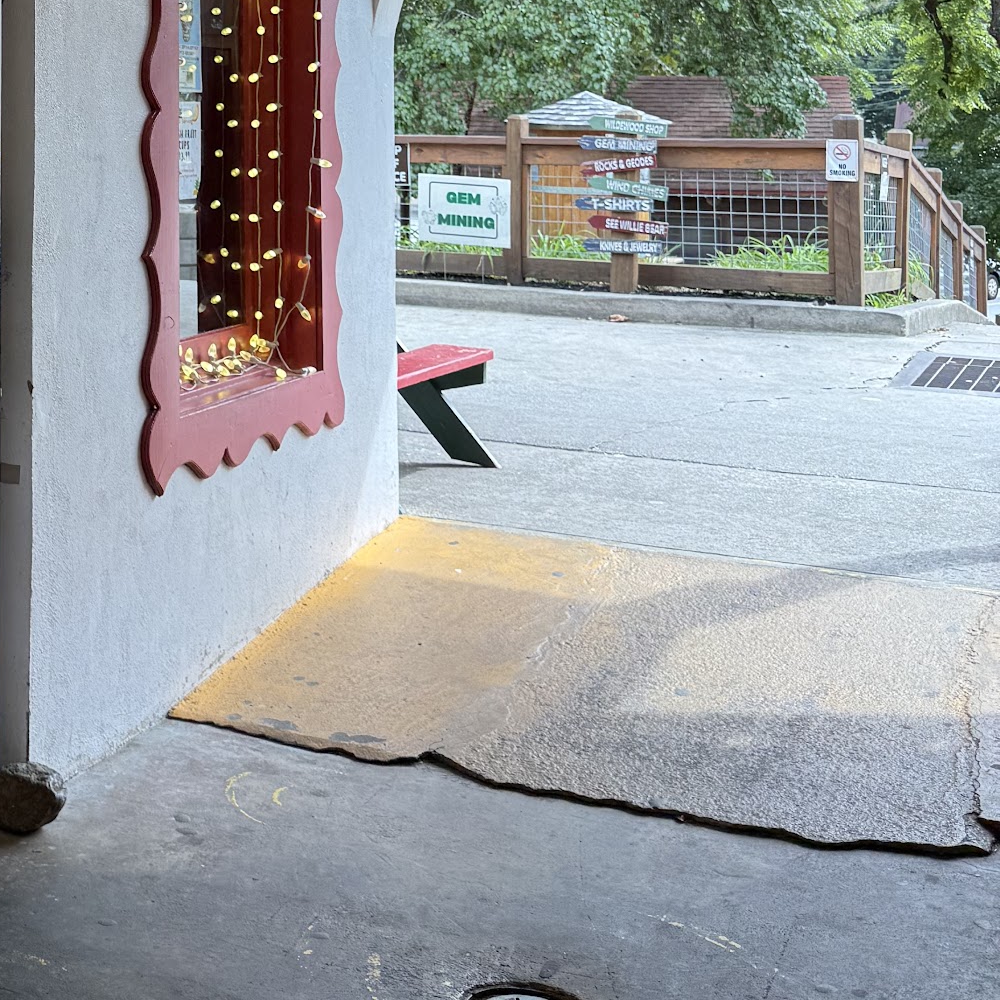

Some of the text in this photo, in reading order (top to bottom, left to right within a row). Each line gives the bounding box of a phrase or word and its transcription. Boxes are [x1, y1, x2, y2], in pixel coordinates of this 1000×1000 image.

[604, 119, 664, 135] WILDEWOOD SHOP
[594, 138, 655, 152] GEM MINING
[594, 155, 654, 172] ROCKS & GEODES
[829, 169, 856, 177] SMOKING
[606, 179, 630, 193] WIND
[446, 191, 481, 206] GEM
[591, 197, 650, 211] T-SHIRTS
[437, 213, 495, 230] MINING
[605, 217, 619, 230] SEE
[619, 220, 644, 233] WILLIE
[600, 241, 658, 253] KNIVES & JEWELRY
